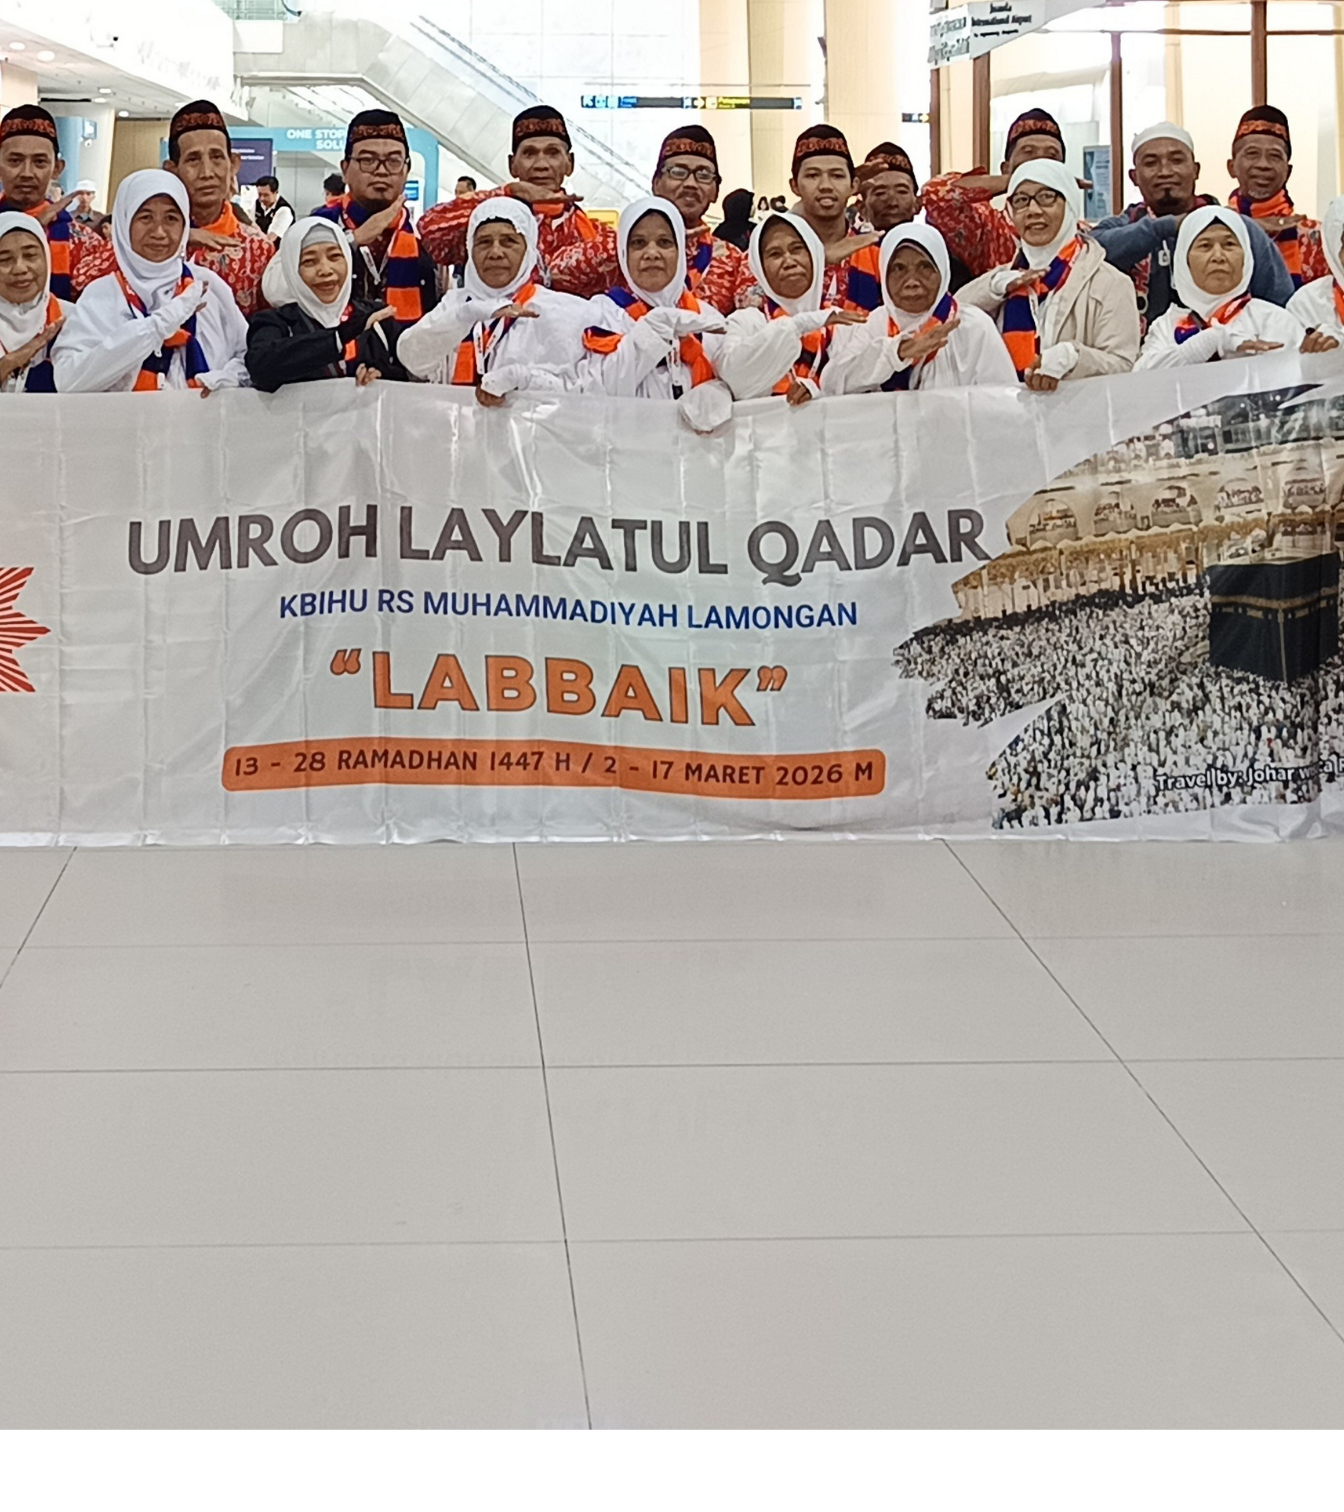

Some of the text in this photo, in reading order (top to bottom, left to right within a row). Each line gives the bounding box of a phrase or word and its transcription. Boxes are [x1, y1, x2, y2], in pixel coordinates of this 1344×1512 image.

[287, 129, 346, 139] ONE STOP
[127, 504, 992, 586] UMROH LAYLATUL QADAR
[280, 589, 858, 630] KBIHU RS MUHAMMADIYAH LAMONGAN
[234, 757, 259, 777] 13
[293, 751, 326, 773] 28
[337, 749, 478, 771] RAMADHAN
[489, 750, 544, 772] 1447
[555, 753, 571, 772] H
[582, 753, 593, 775] /
[604, 756, 617, 775] 2
[652, 760, 674, 781] 17
[684, 763, 764, 786] MARET
[776, 763, 843, 786] 2026
[854, 761, 873, 783] M
[1156, 770, 1211, 790] Travel
[1217, 769, 1244, 788] by:
[1246, 766, 1295, 786] Johar
